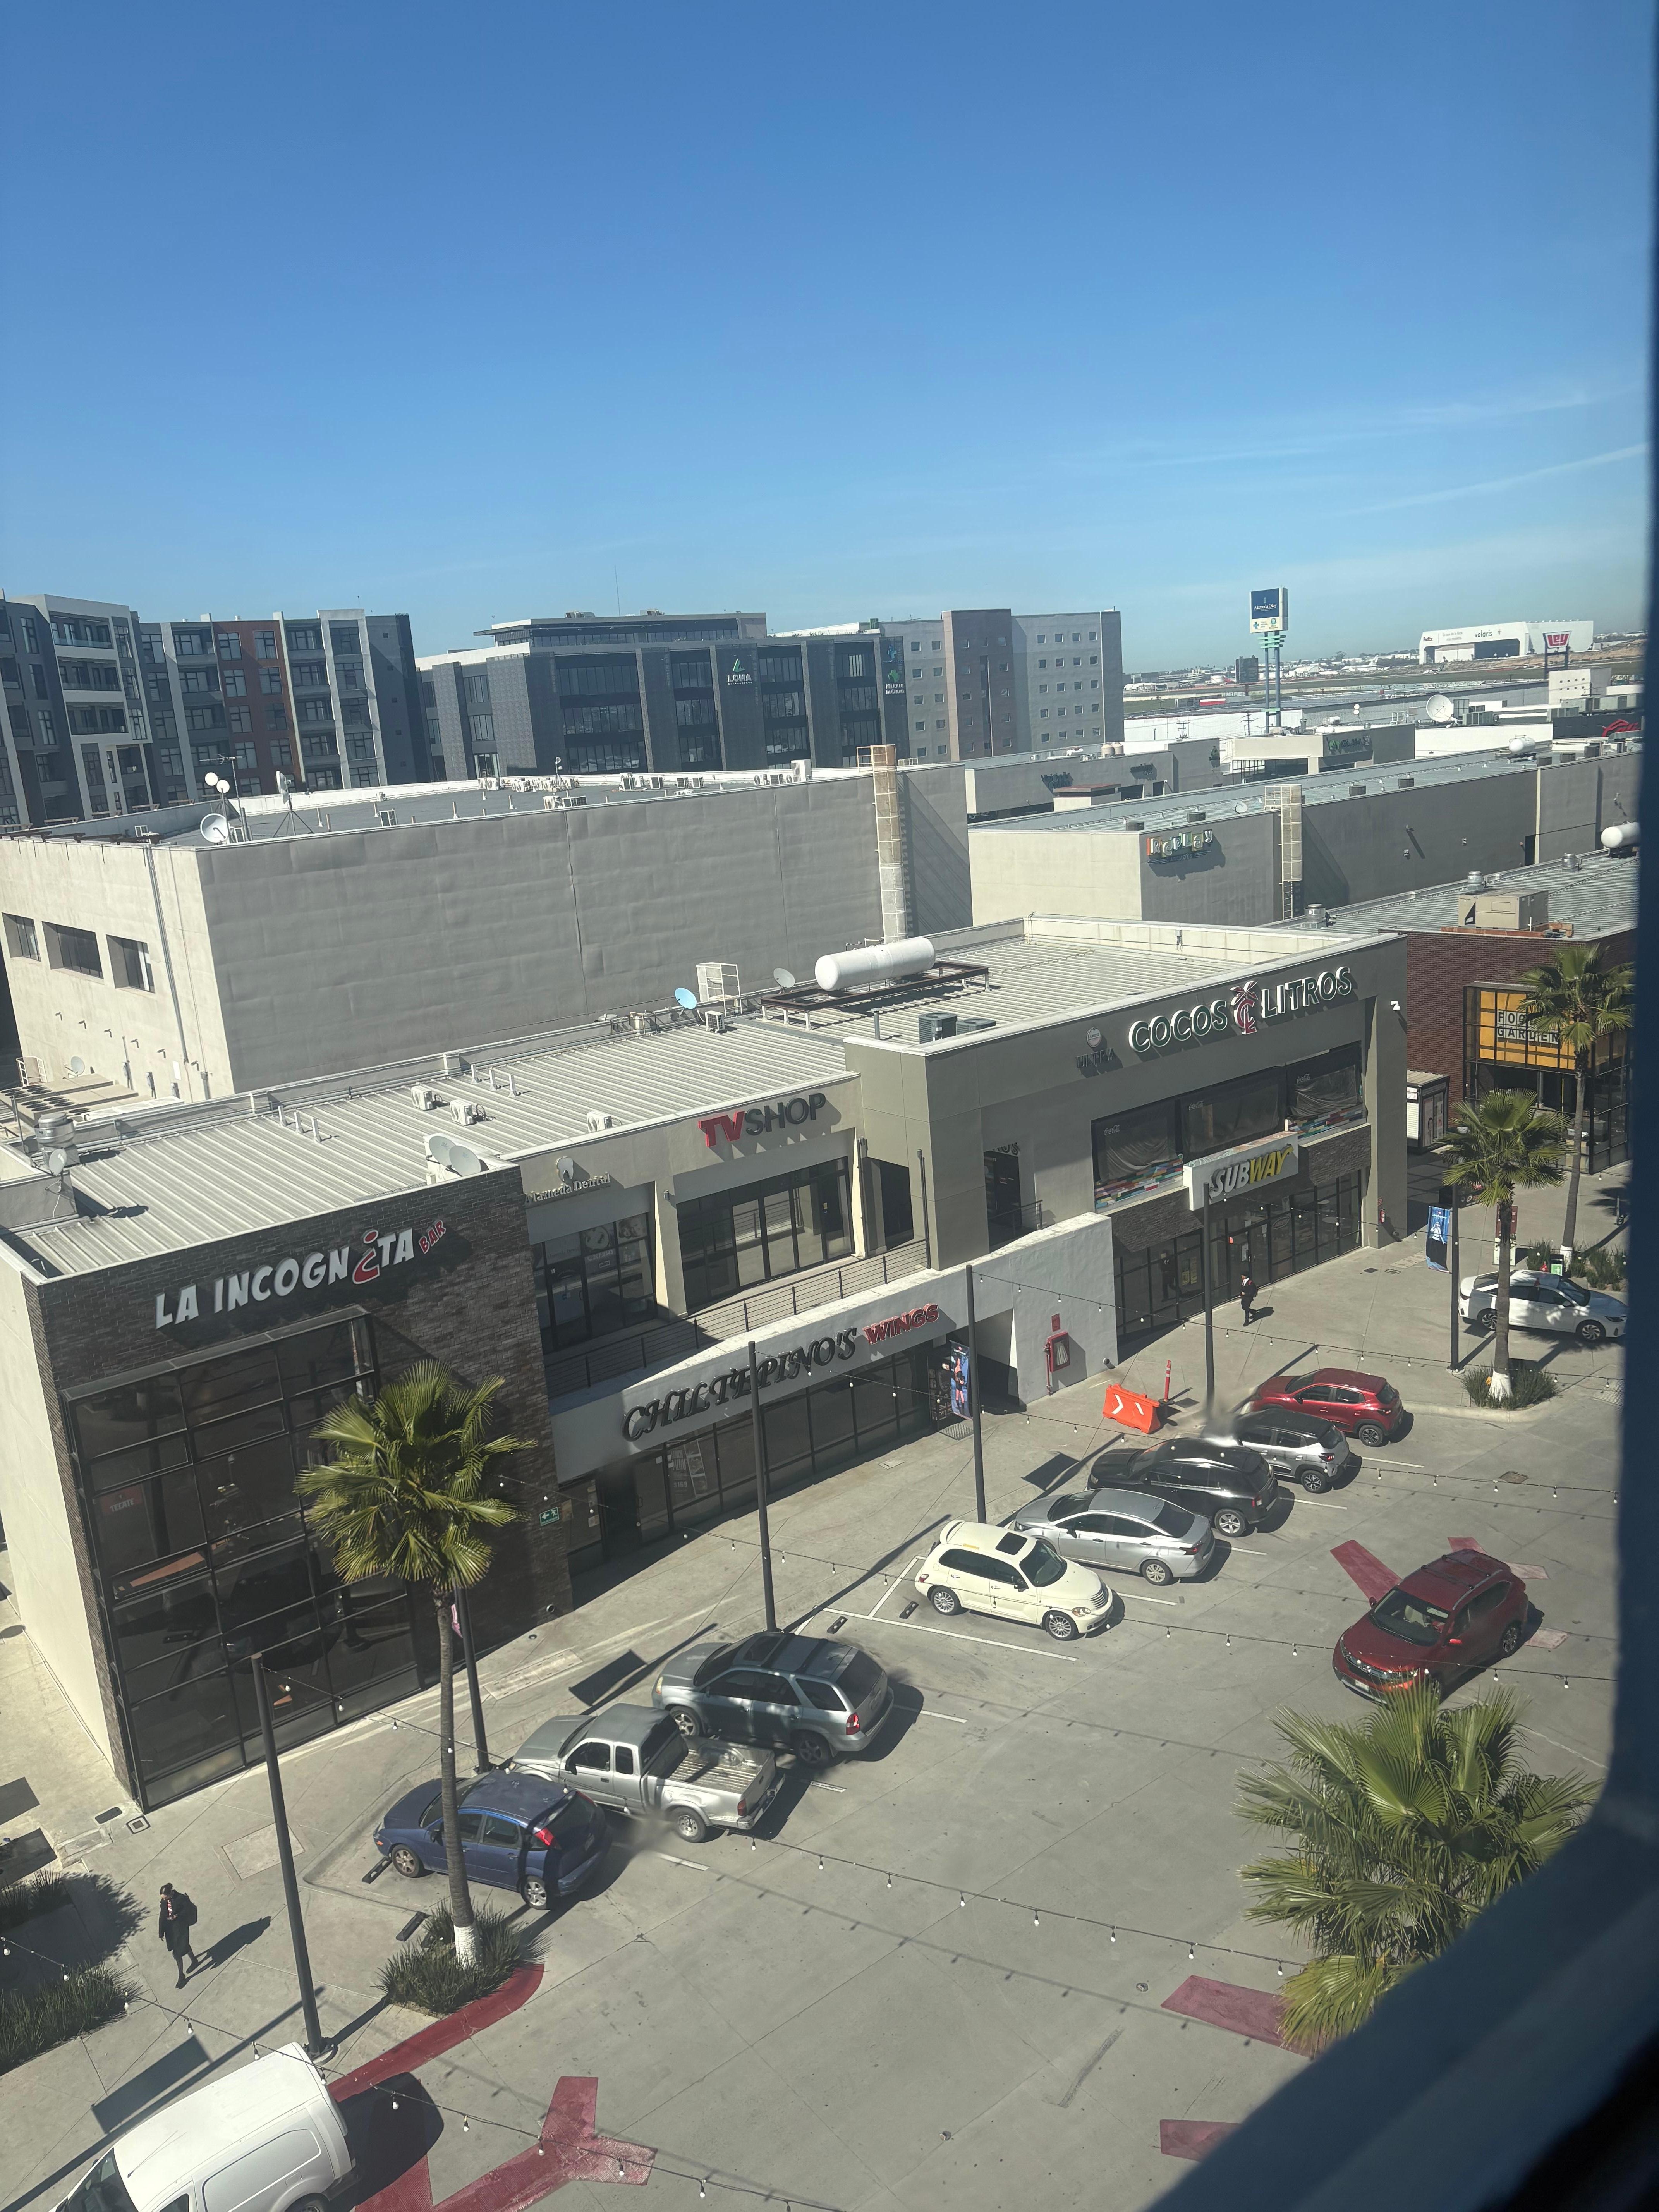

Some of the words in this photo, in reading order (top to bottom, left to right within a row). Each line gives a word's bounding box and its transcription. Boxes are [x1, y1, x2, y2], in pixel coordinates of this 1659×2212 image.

[1475, 630, 1493, 638] volaris
[727, 674, 752, 682] LOMA
[1128, 1000, 1228, 1053] COCOS
[1261, 966, 1352, 1019] LITROS
[1498, 1012, 1532, 1024] FOO
[524, 1183, 572, 1207] Alameda
[573, 1171, 611, 1191] Dental
[1209, 1145, 1294, 1198] SUBWAY
[419, 1219, 447, 1254] BAR
[156, 1284, 199, 1330] LA
[622, 1326, 857, 1442] CHILTEPINO'S
[862, 1303, 939, 1346] WINGS
[109, 1498, 135, 1512] TECATE
